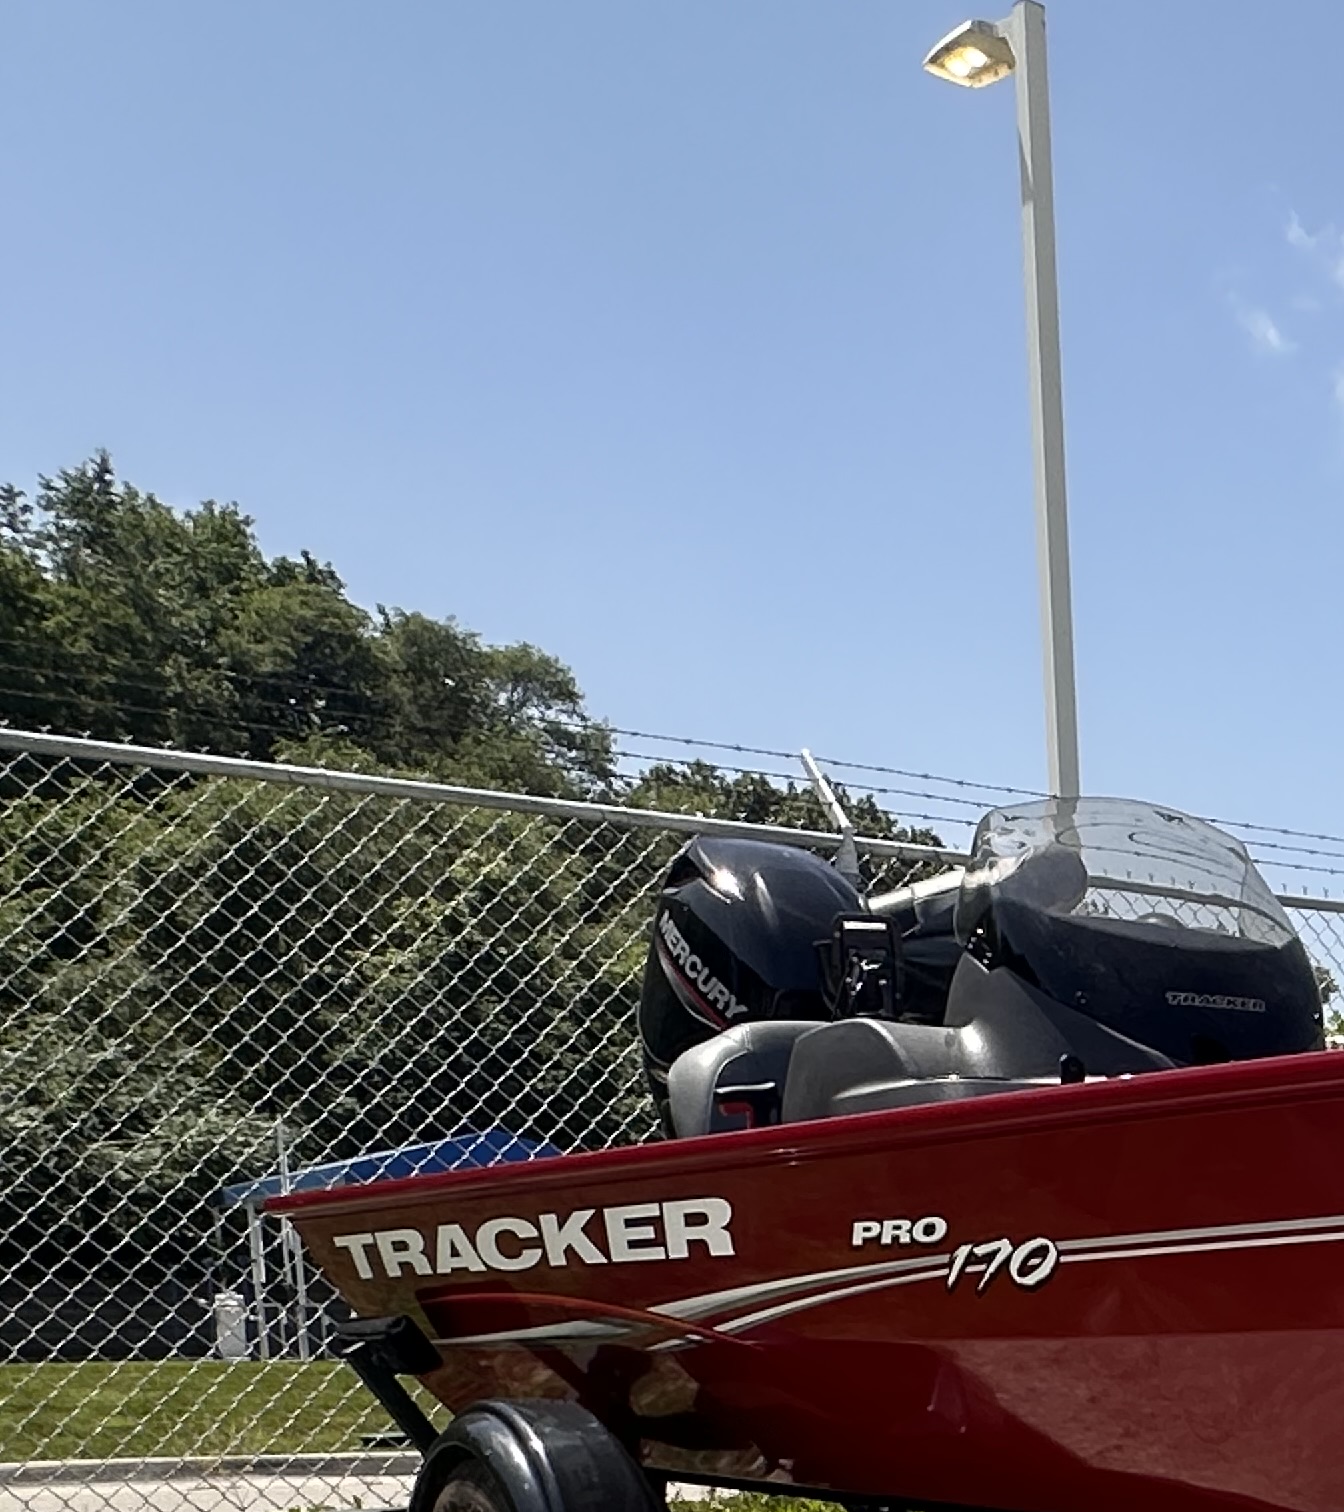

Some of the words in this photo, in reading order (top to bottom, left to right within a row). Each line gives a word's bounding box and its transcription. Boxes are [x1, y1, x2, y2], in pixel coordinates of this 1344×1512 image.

[659, 909, 749, 1018] MERCURY
[1165, 991, 1266, 1013] TRACKER
[333, 1197, 735, 1279] TRACKER
[852, 1216, 948, 1246] PRO
[947, 1237, 1058, 1291] 170
